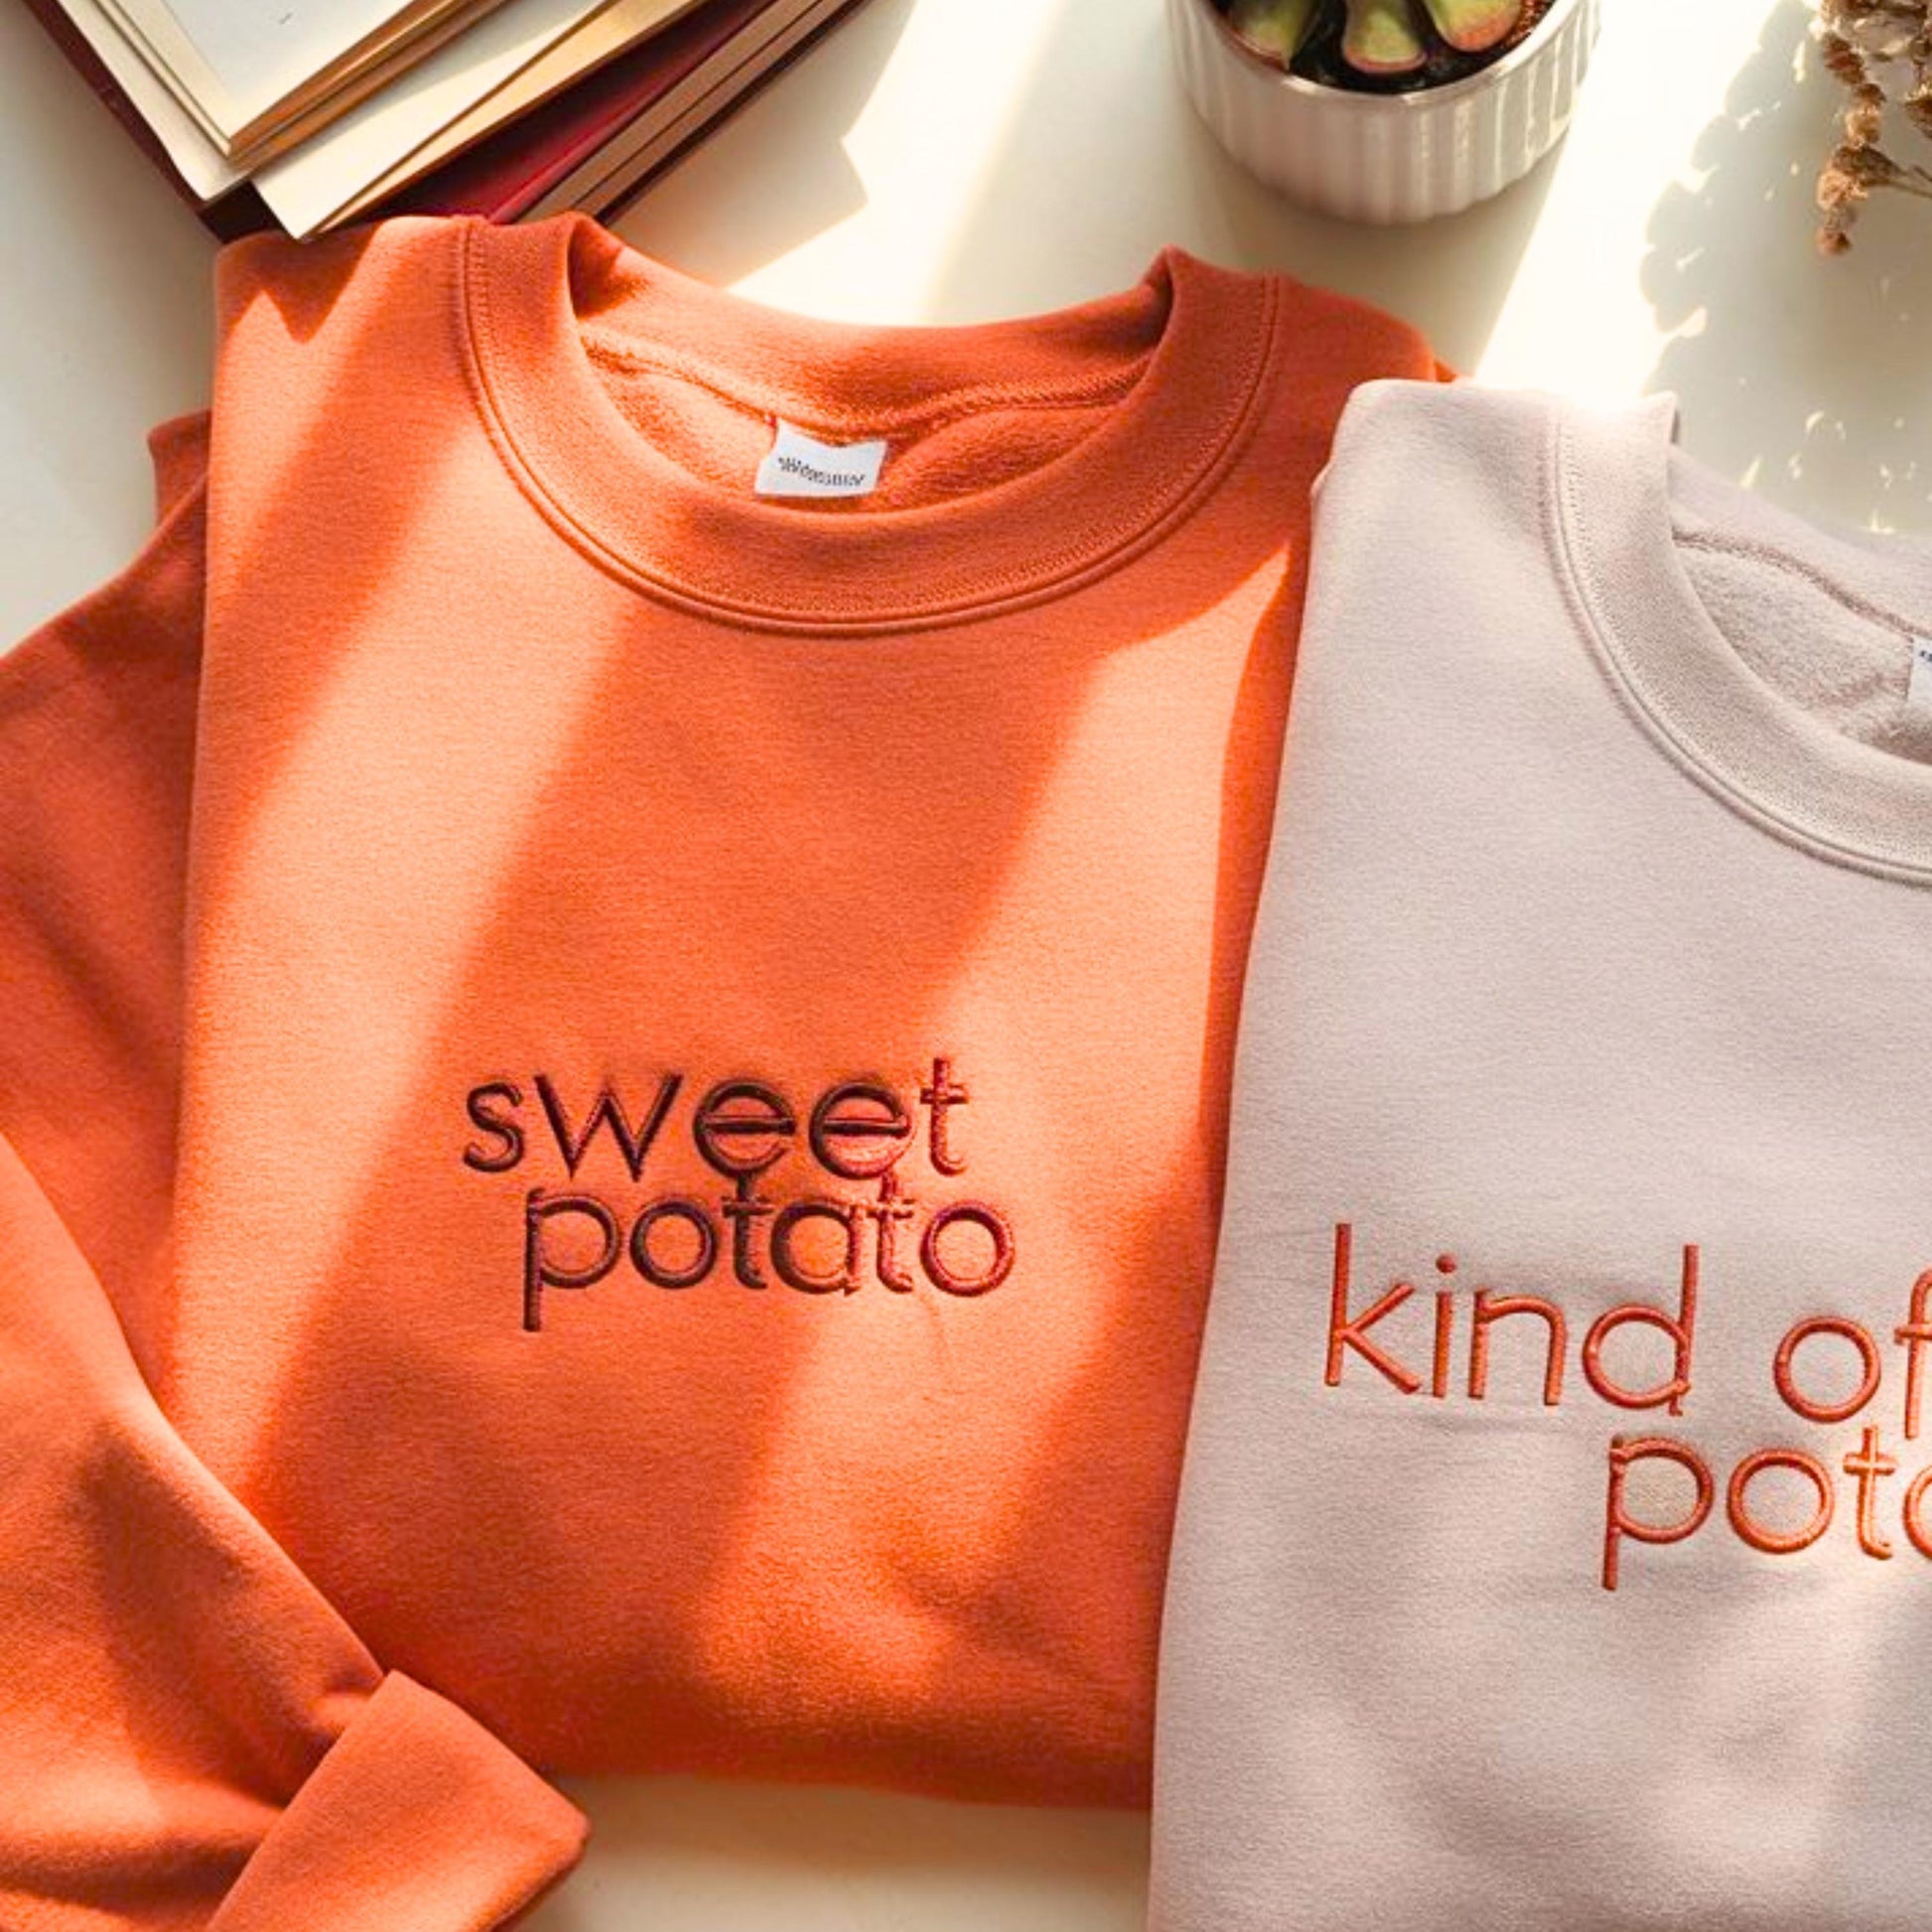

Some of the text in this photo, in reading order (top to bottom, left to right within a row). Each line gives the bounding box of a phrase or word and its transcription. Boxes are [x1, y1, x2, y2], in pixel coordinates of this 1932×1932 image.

[463, 1056, 970, 1182] sweet
[522, 1172, 1017, 1333] potato
[1323, 1222, 1932, 1440] kind of
[1595, 1424, 1932, 1592] pot
